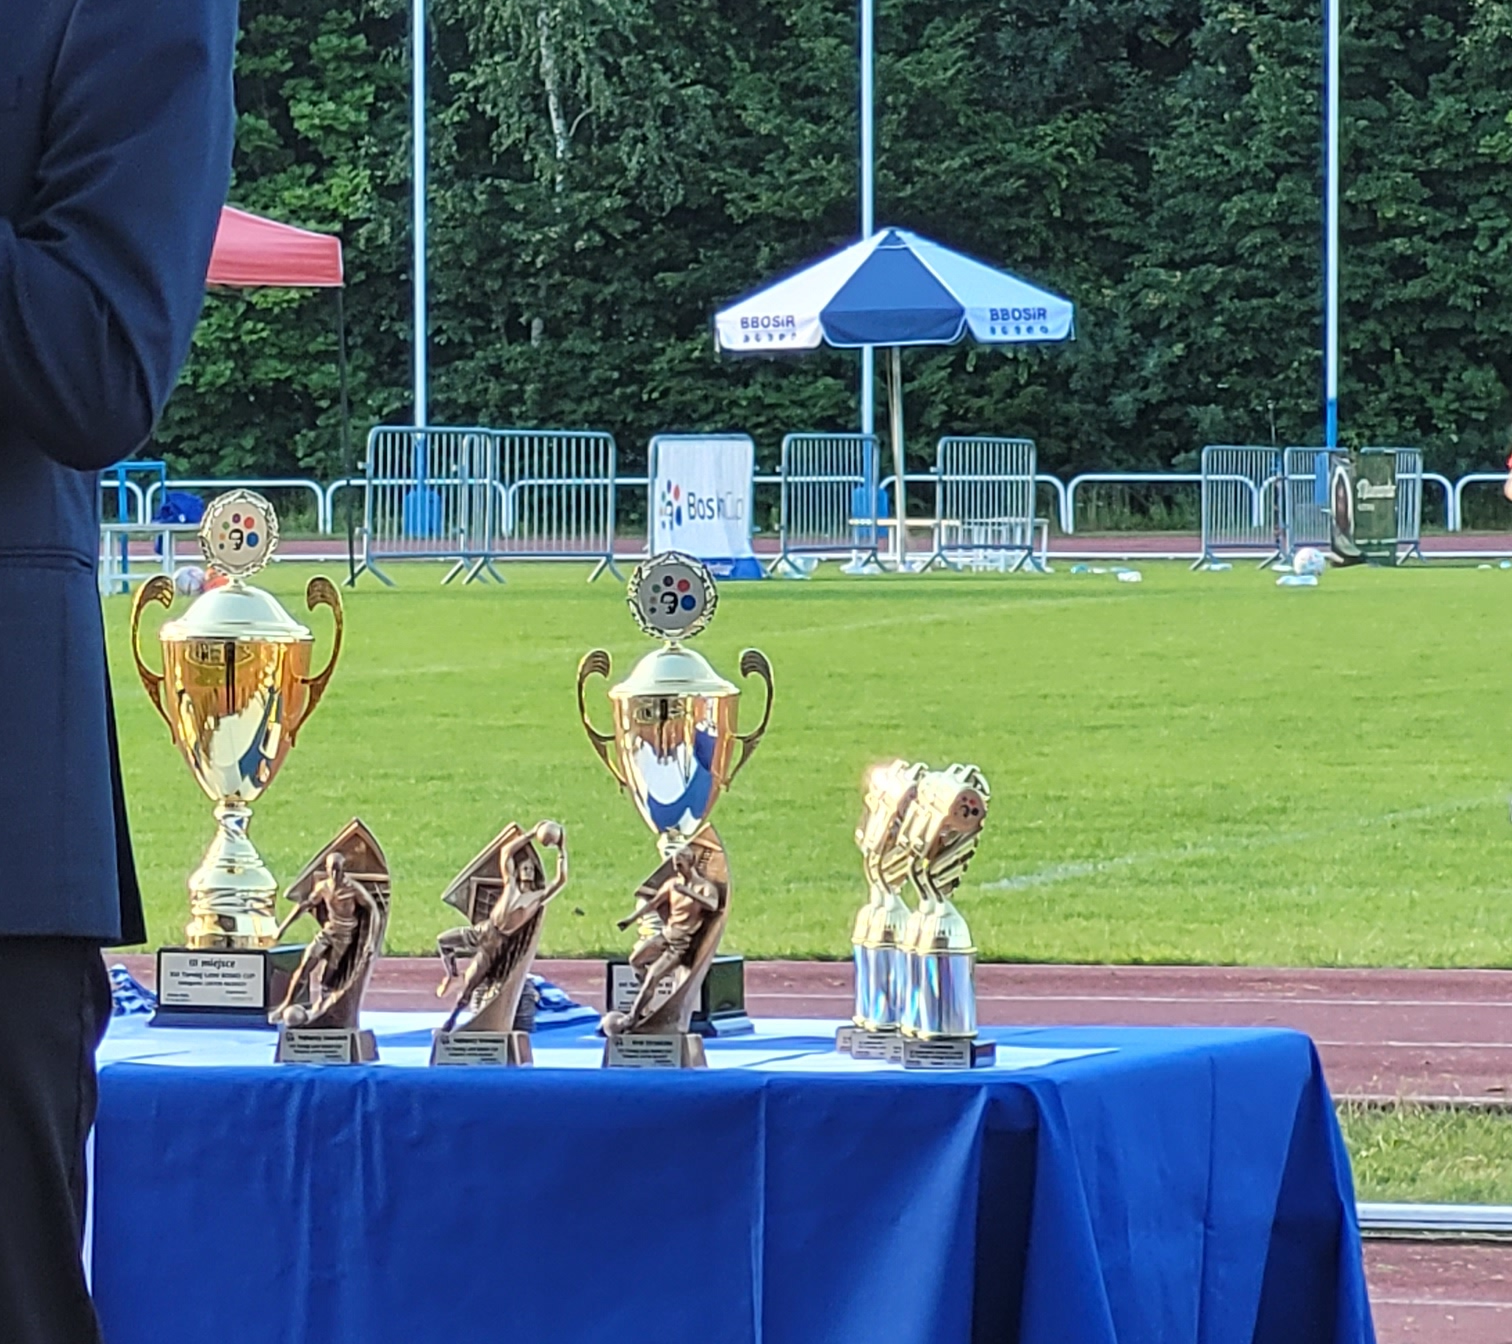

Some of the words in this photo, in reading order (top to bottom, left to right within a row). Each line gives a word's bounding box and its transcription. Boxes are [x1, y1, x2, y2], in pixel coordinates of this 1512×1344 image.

[989, 307, 1047, 322] BBOSiR
[740, 315, 796, 329] BBOSiR
[201, 958, 236, 970] miejsce
